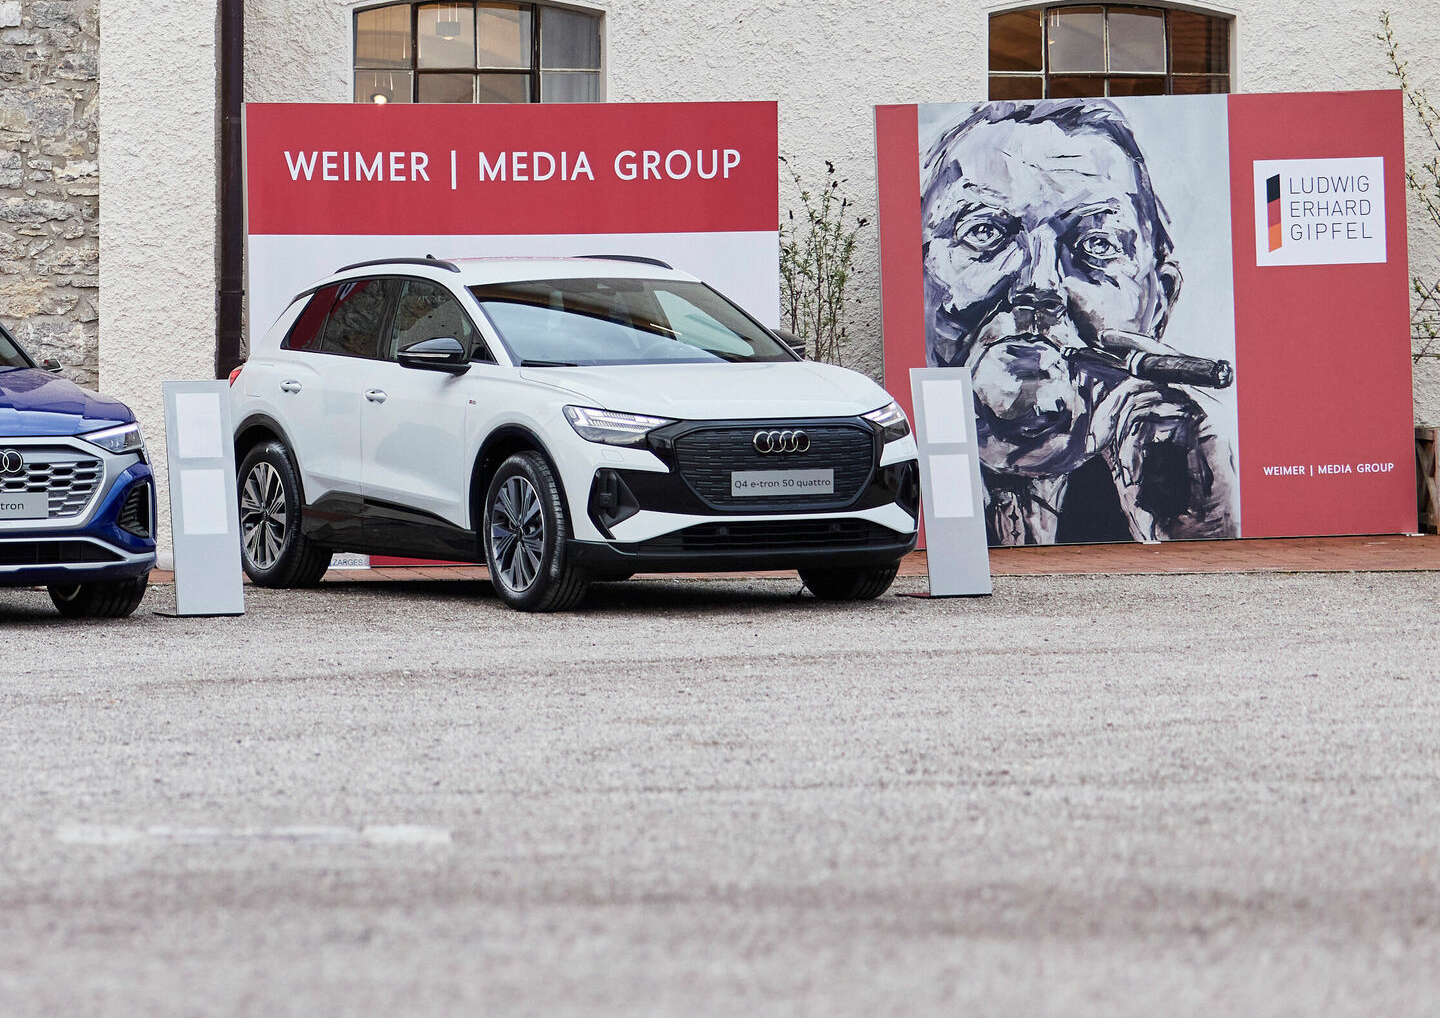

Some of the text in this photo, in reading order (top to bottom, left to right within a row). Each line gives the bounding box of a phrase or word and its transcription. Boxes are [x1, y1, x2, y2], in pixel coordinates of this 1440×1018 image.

[283, 150, 430, 182] WEIMER
[478, 150, 595, 182] MEDIA
[613, 148, 742, 181] GROUP
[1289, 175, 1370, 195] LUDWIG
[1290, 199, 1371, 218] ERHARD
[1290, 222, 1373, 241] GIPFEL
[1263, 465, 1306, 476] WEIMER
[1317, 464, 1353, 474] MEDIA
[1356, 462, 1395, 473] GROUP
[734, 479, 831, 489] Q4 e-tron 50 quattro
[332, 558, 364, 567] ZARGES
